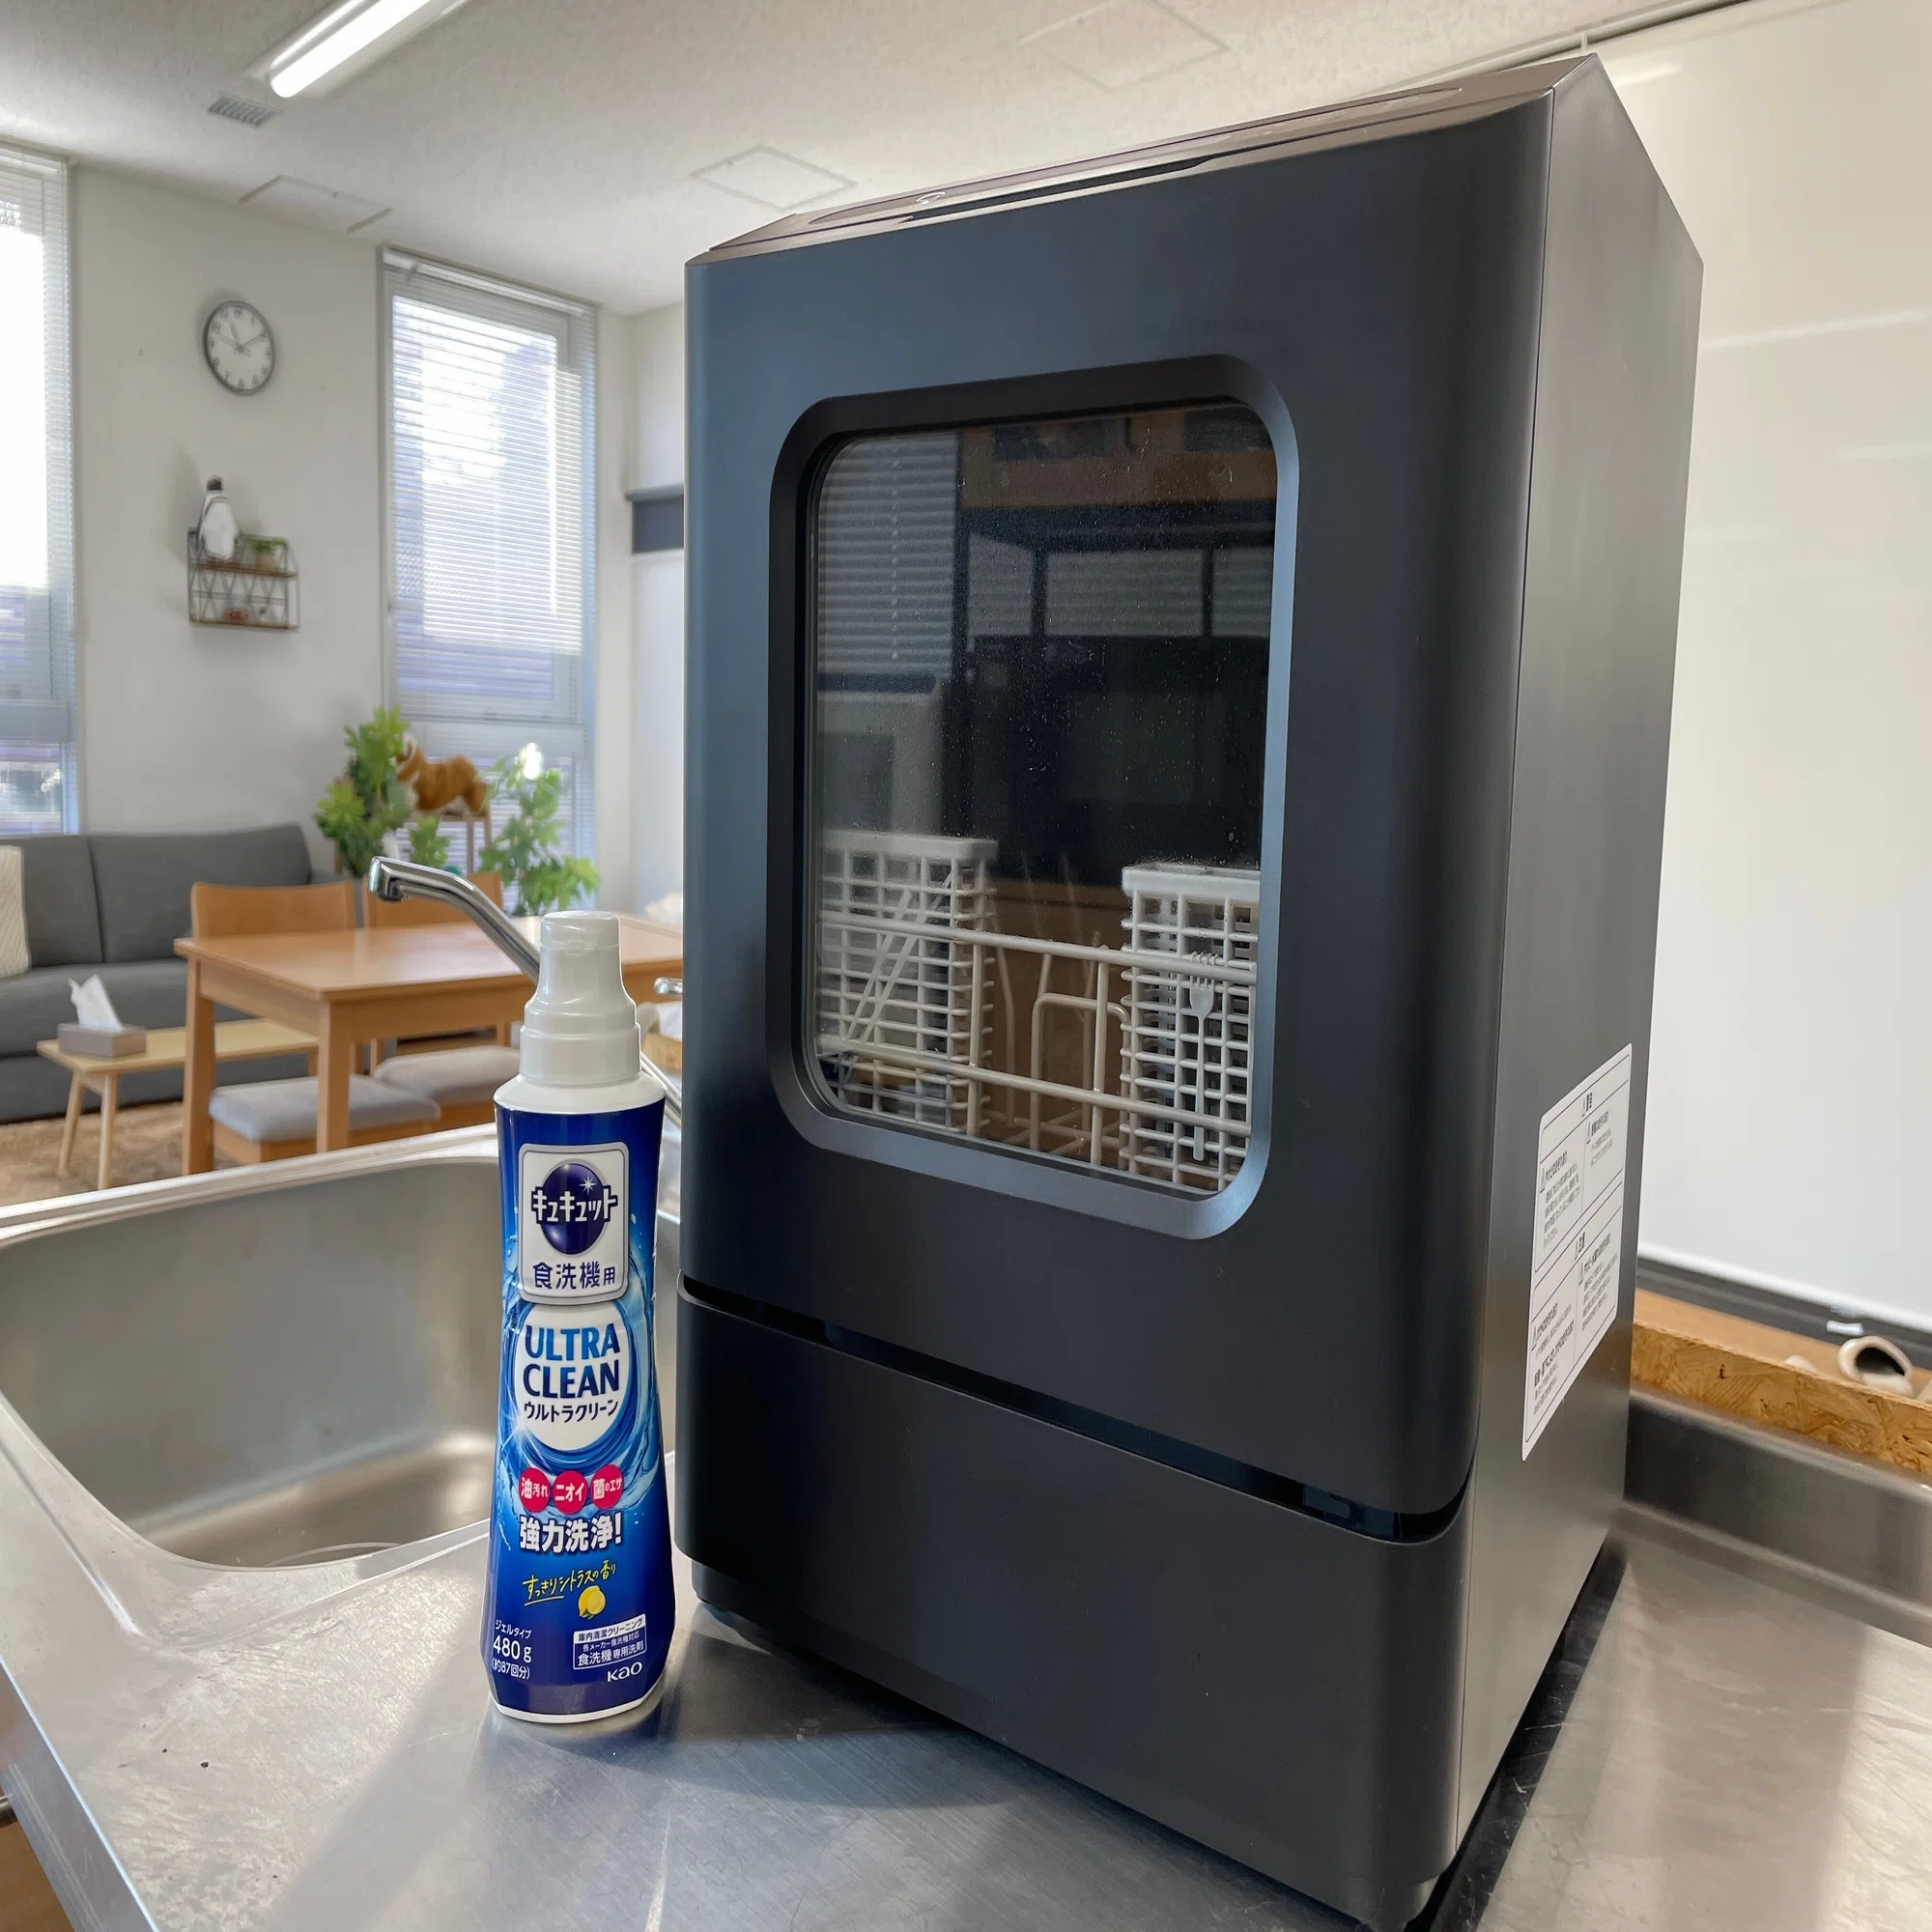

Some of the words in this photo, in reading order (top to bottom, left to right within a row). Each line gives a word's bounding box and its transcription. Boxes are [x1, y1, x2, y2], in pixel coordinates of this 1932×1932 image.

[532, 1186, 617, 1224] キュキュット
[532, 1261, 615, 1290] 食洗機用
[525, 1322, 621, 1361] ULTRA
[523, 1359, 619, 1399] CLEAN
[524, 1399, 618, 1423] ウルトラクリーン
[522, 1476, 549, 1499] 油汚れ
[554, 1482, 585, 1502] ニオイ
[593, 1477, 622, 1499] 菌のエサ
[496, 1619, 532, 1639] ジェルタイプ
